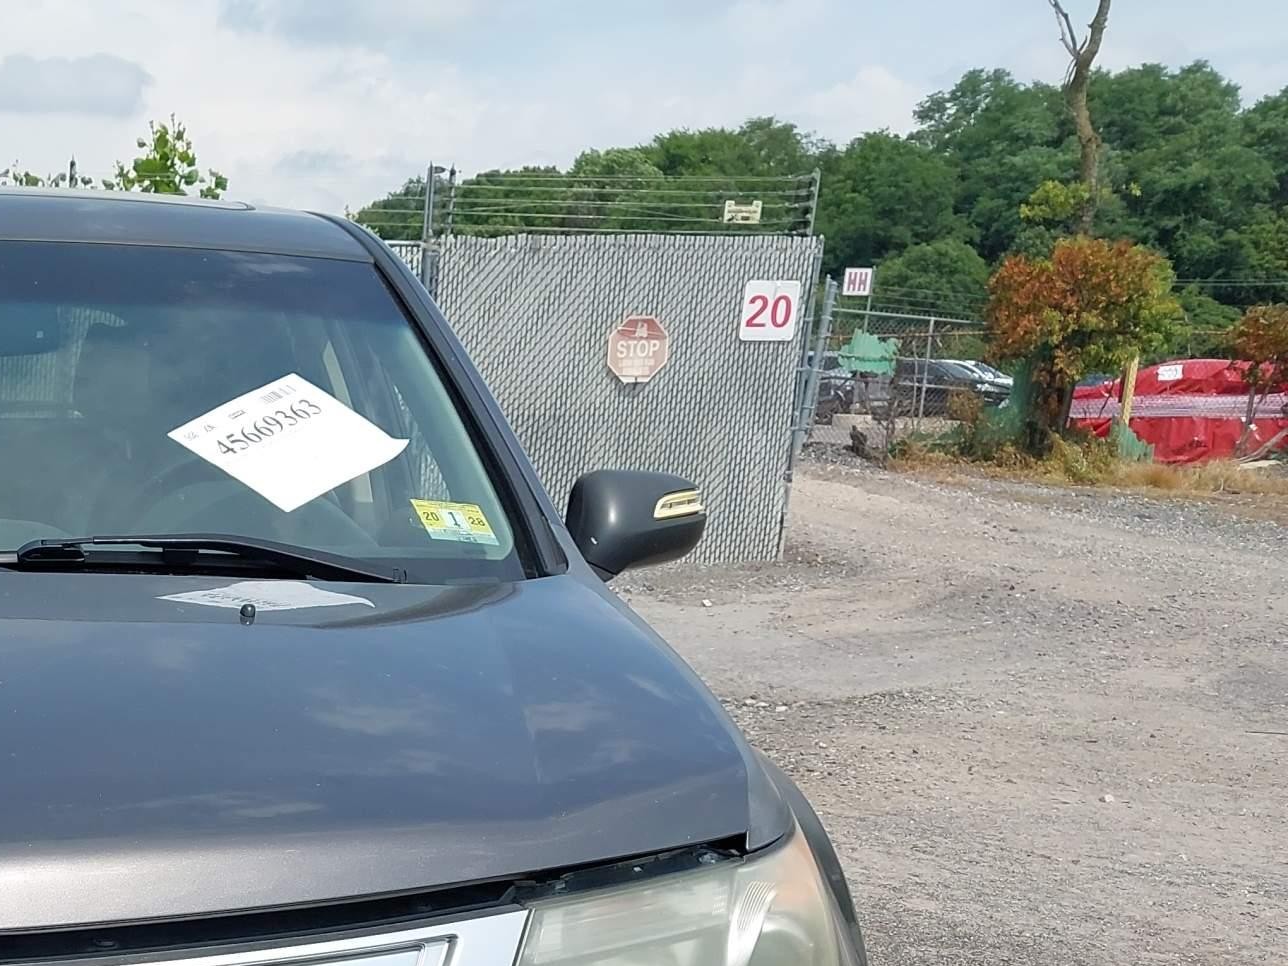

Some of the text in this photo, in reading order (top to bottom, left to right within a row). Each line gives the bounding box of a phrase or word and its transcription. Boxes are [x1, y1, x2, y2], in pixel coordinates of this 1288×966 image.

[847, 271, 868, 292] HH
[745, 294, 793, 328] 20
[616, 340, 661, 358] STOP
[216, 399, 322, 455] 45669363
[422, 511, 440, 522] 20
[447, 511, 461, 527] 1
